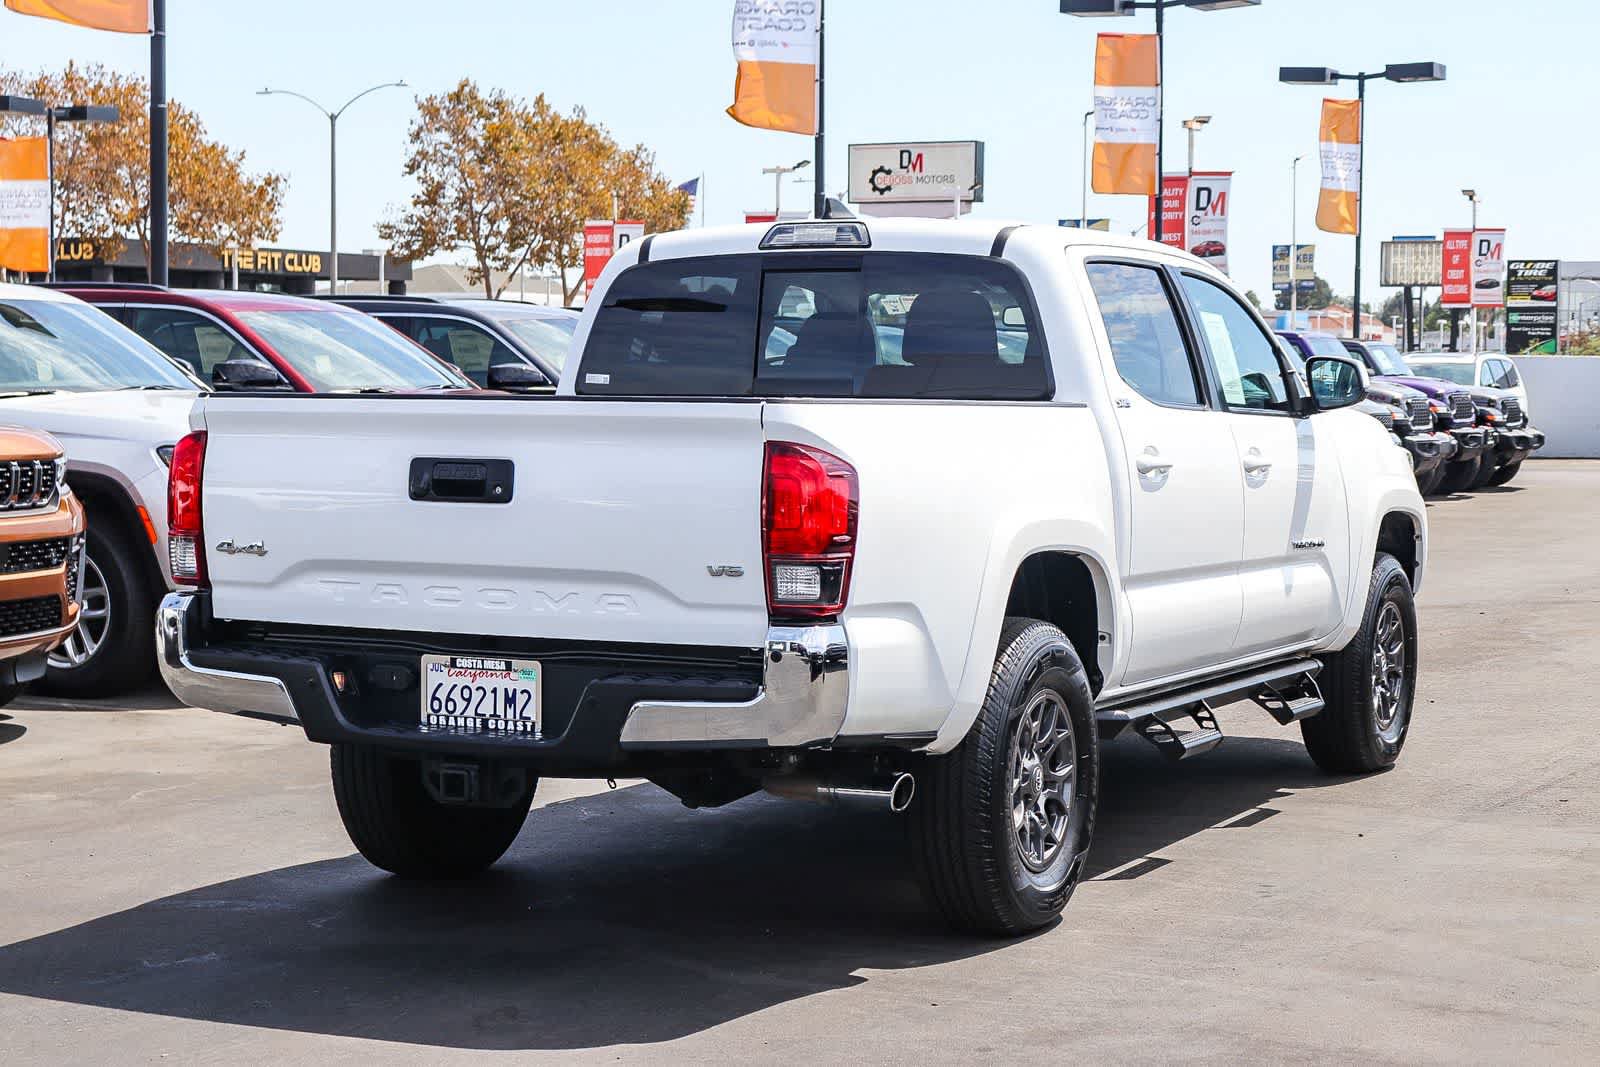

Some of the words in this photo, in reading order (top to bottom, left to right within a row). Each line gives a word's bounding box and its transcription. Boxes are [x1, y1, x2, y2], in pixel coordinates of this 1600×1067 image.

[915, 174, 955, 184] MOTORS
[1162, 187, 1185, 196] ALITY
[1195, 187, 1226, 216] DM
[56, 243, 94, 260] LUB
[1479, 239, 1502, 260] DM
[257, 251, 281, 272] FIT
[285, 253, 321, 272] CLUB
[706, 565, 745, 577] V6
[318, 578, 641, 615] TACOMA
[430, 663, 444, 673] JUL
[456, 658, 482, 669] COSTA
[484, 660, 506, 670] MESA
[448, 668, 519, 683] California
[430, 682, 532, 721] 66921M2
[430, 715, 482, 728] ORANGE
[488, 719, 533, 732] COAST
